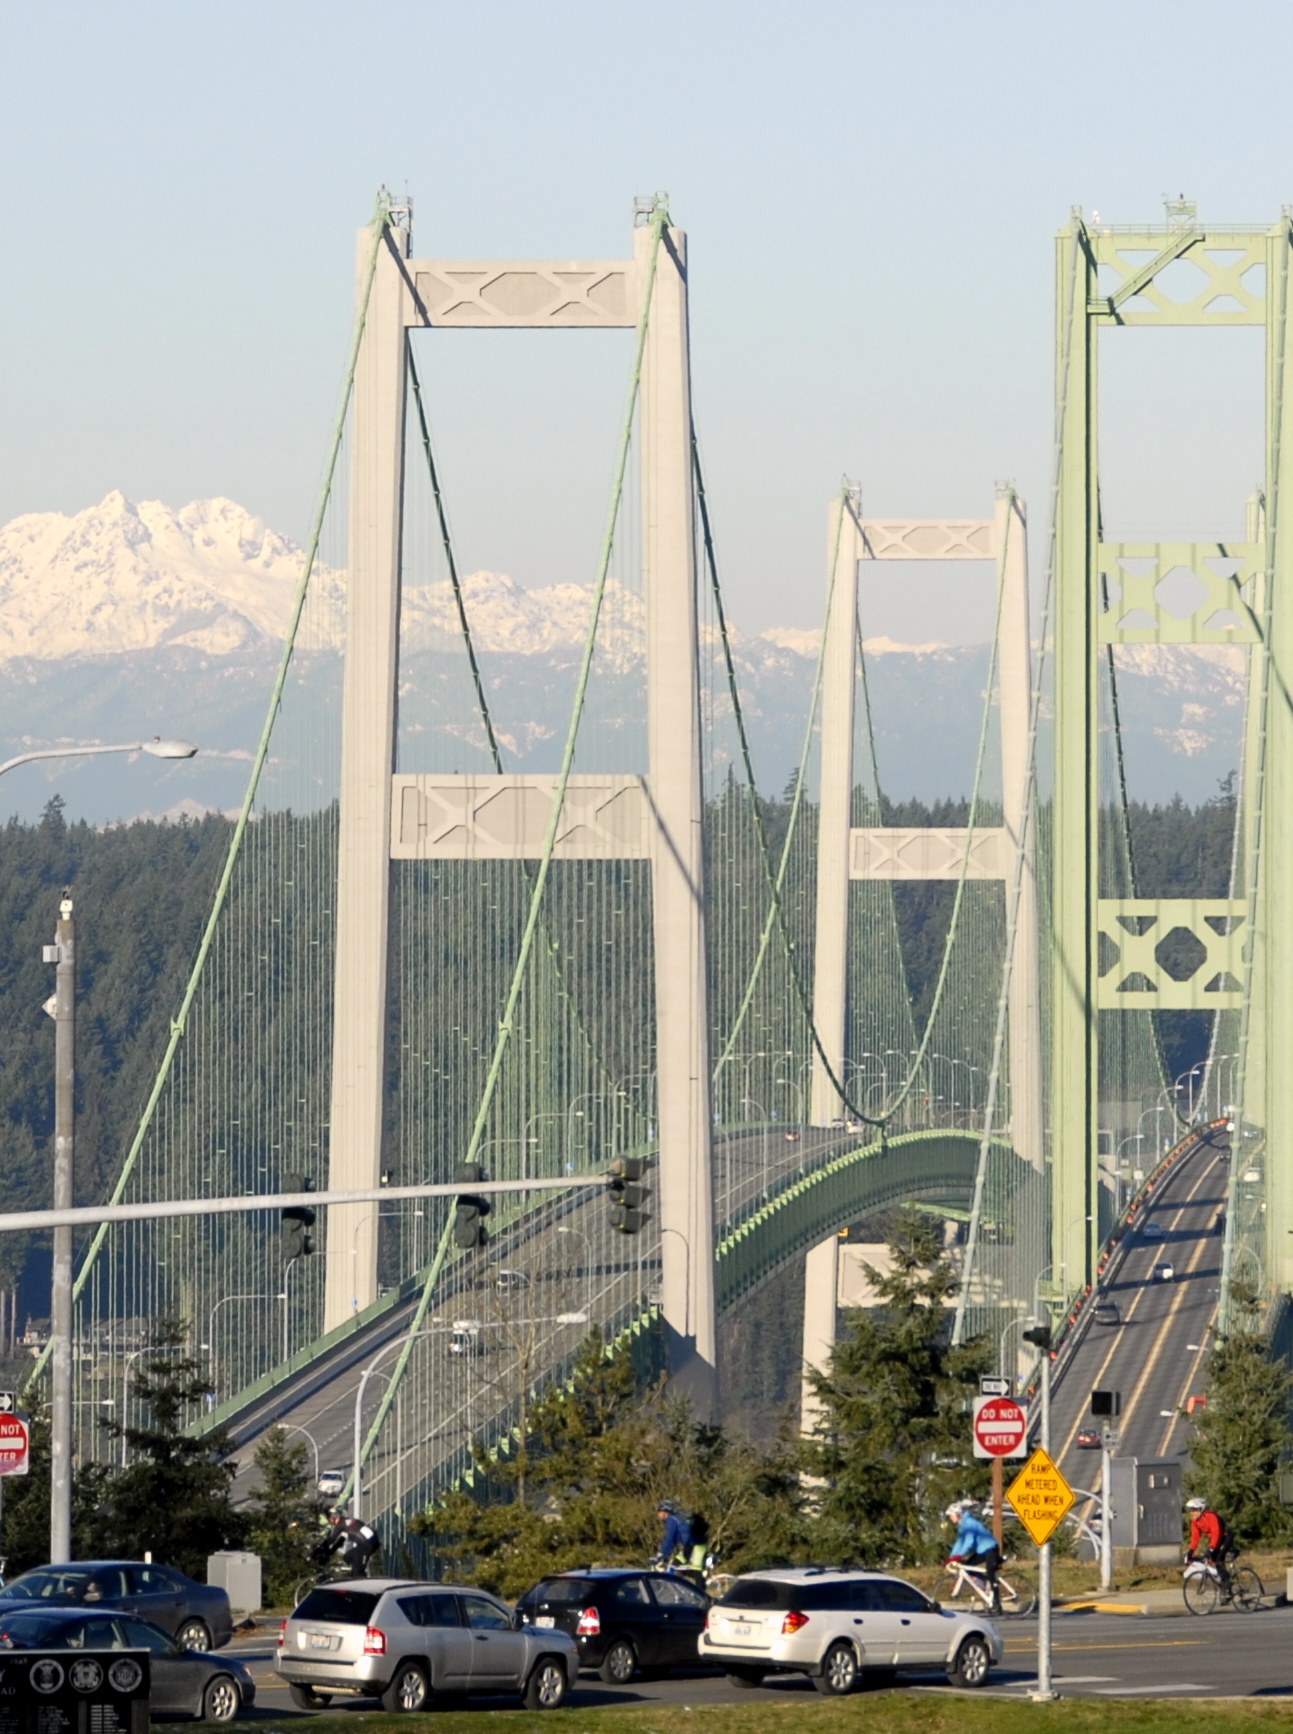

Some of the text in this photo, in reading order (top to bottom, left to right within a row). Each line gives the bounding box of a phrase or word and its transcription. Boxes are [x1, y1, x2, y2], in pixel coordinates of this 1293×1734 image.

[982, 1408, 1019, 1419] DO NOT
[1, 1424, 20, 1435] NOT
[985, 1435, 1015, 1446] ENTER
[1031, 1464, 1051, 1474] RAMP
[1025, 1479, 1057, 1490] METERED
[1017, 1494, 1064, 1506] AHEAD WHEN
[1024, 1509, 1058, 1520] FLASHING
